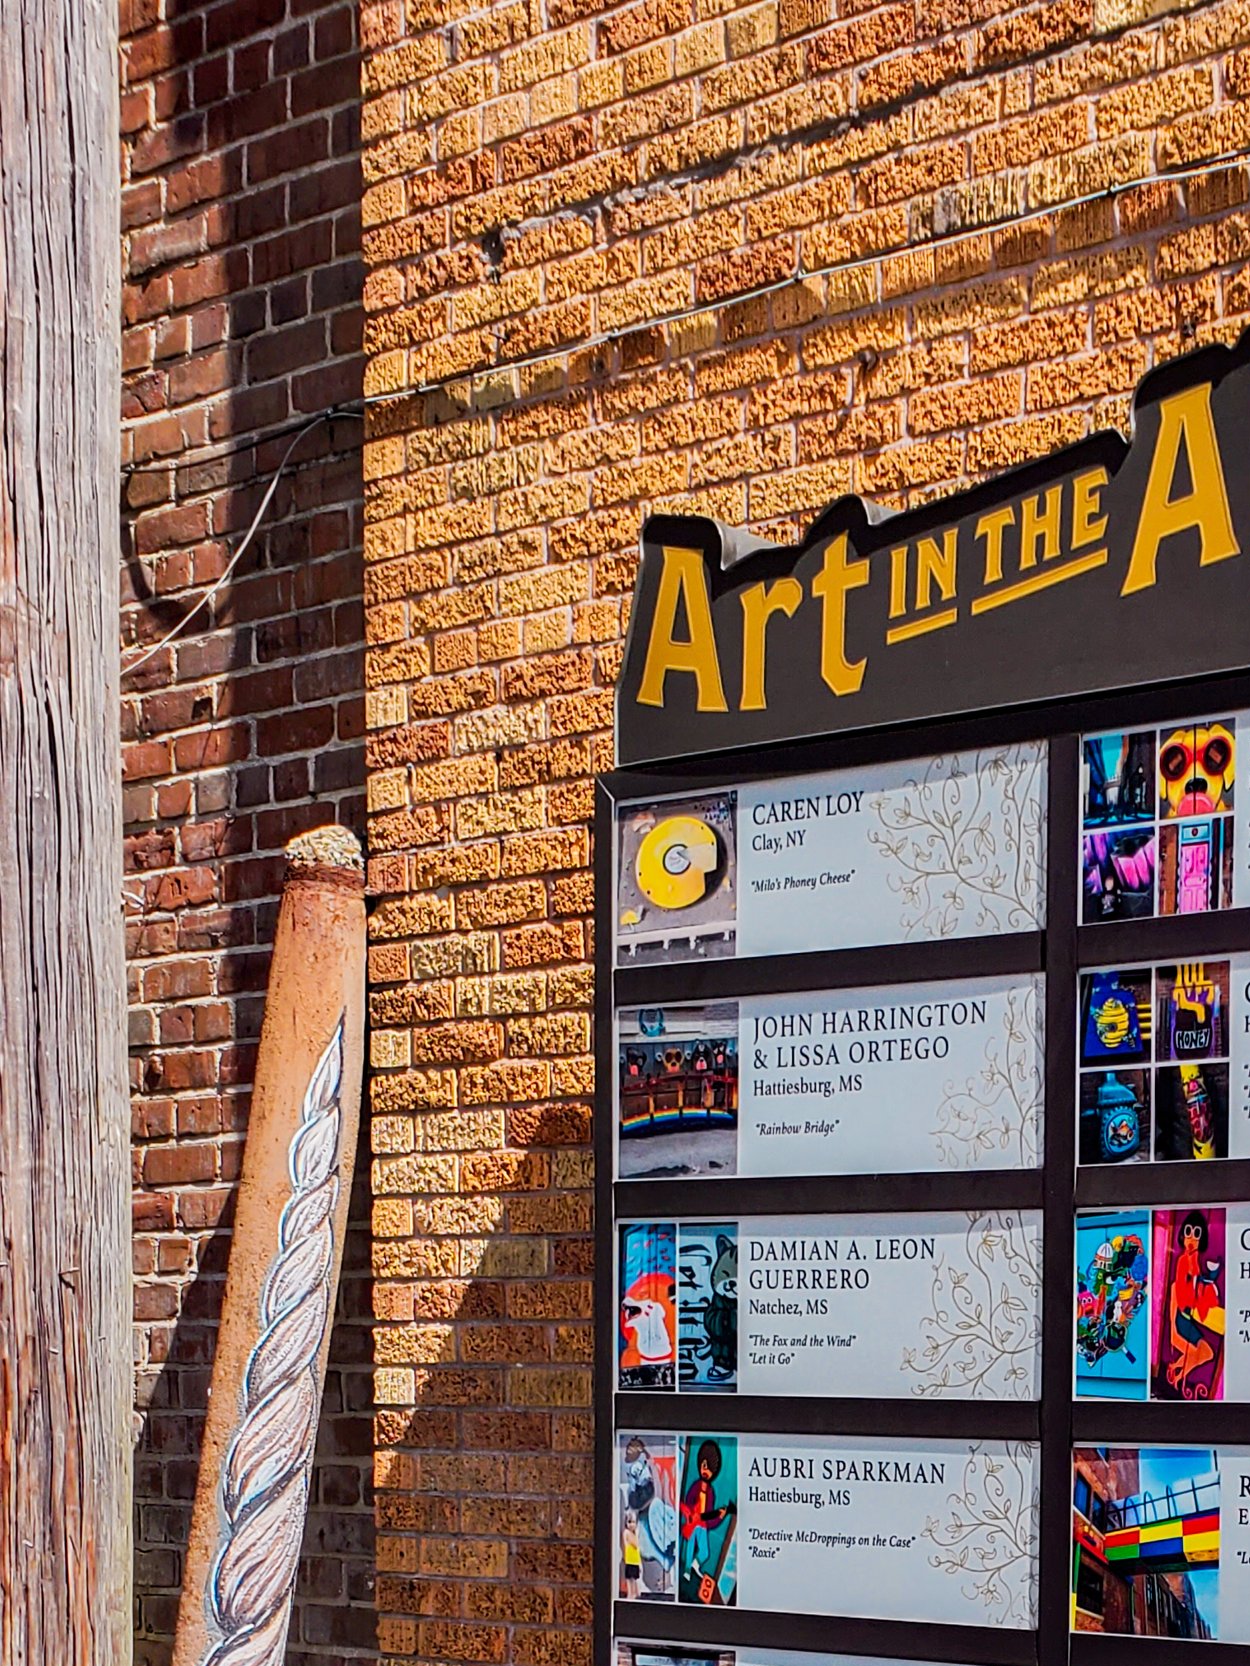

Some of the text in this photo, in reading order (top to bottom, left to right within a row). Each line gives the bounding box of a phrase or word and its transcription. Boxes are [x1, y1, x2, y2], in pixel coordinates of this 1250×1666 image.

[637, 534, 869, 712] Art
[889, 527, 959, 618] IN
[974, 465, 1110, 583] THE
[753, 790, 864, 825] CAREN LOY
[752, 829, 806, 854] Clay, NY
[784, 876, 817, 890] Phoney
[754, 1000, 986, 1045] JOHN HARRINGTON
[753, 1036, 949, 1069] & LISSA ORTEGO
[754, 1074, 862, 1098] Hattiesburg, MS
[750, 1238, 935, 1261] DAMIAN A. LEON
[749, 1268, 869, 1289] GUERRERO
[749, 1298, 828, 1317] Natchez, MS
[772, 1335, 788, 1346] Fox
[790, 1334, 808, 1346] and
[810, 1334, 824, 1347] the
[769, 1353, 775, 1364] it
[748, 1457, 945, 1484] AUBRI SPARKMAN
[749, 1486, 850, 1509] Hattiesburg, MS
[795, 1530, 856, 1548] McDroppings
[858, 1537, 869, 1546] on
[872, 1534, 887, 1547] the
